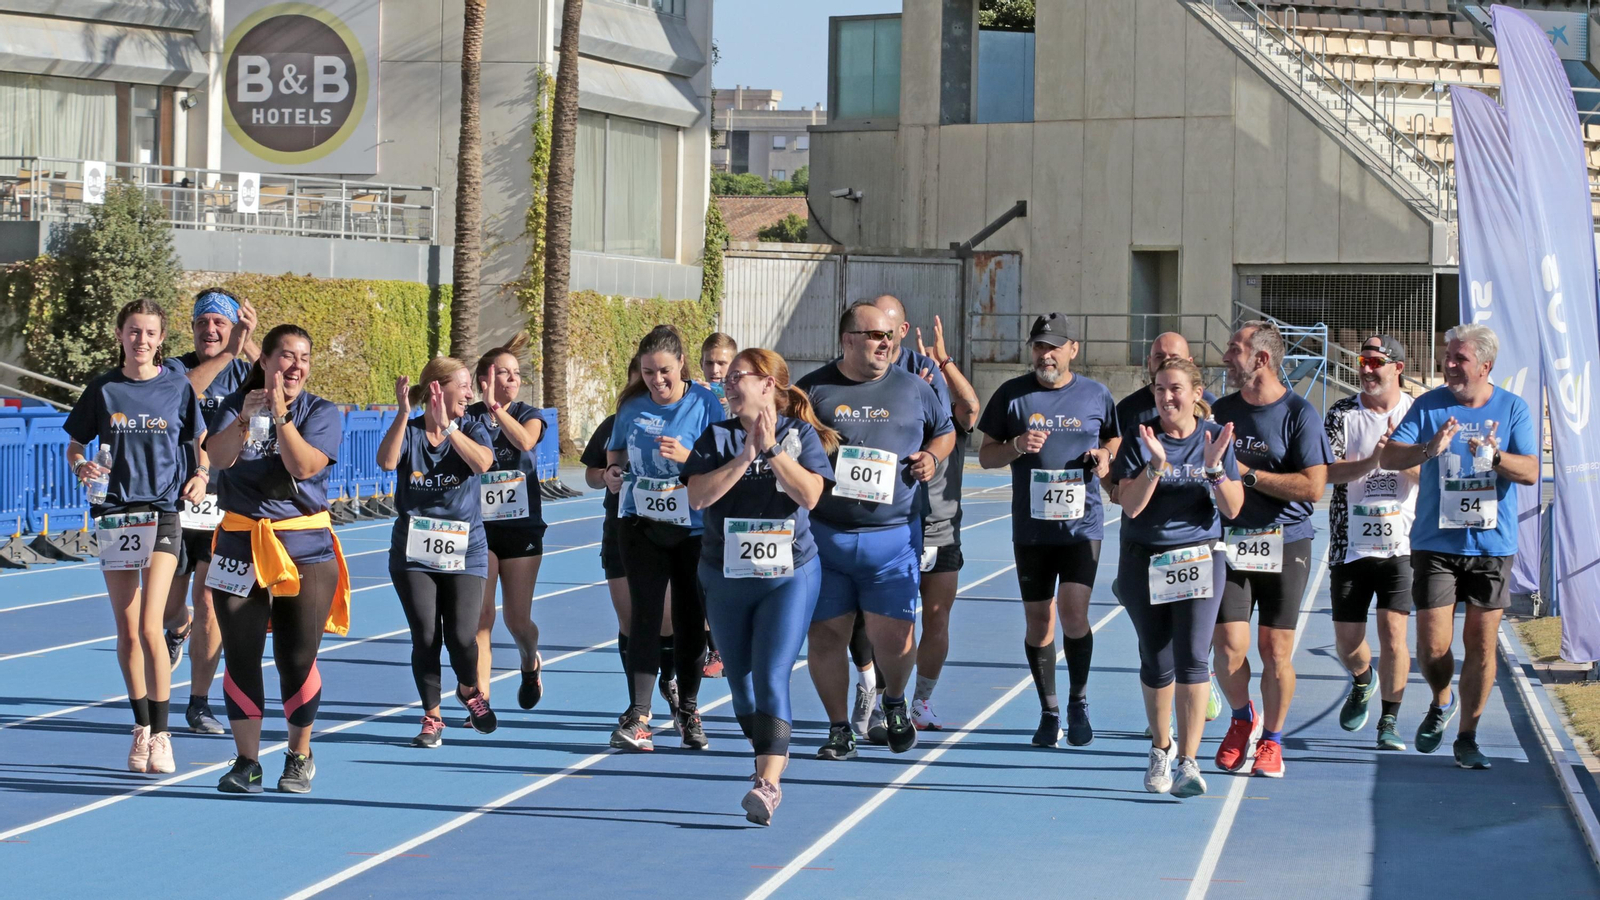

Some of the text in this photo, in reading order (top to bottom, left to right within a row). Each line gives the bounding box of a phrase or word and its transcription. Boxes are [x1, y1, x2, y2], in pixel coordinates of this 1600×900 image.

[237, 55, 350, 103] B&B
[252, 108, 332, 125] HOTELS
[834, 405, 860, 419] Me
[110, 413, 137, 430] Me
[1029, 414, 1054, 428] Me
[1461, 422, 1480, 432] XLI
[410, 471, 433, 488] Me
[850, 465, 882, 485] 601
[485, 488, 517, 505] 612
[645, 496, 678, 512] 266
[1042, 489, 1075, 504] 475
[1460, 498, 1482, 513] 54
[1362, 522, 1393, 537] 233
[119, 534, 142, 551] 23
[423, 537, 456, 555] 186
[740, 541, 778, 560] 260
[1237, 541, 1271, 557] 848
[217, 557, 251, 576] 493
[1165, 566, 1200, 585] 568
